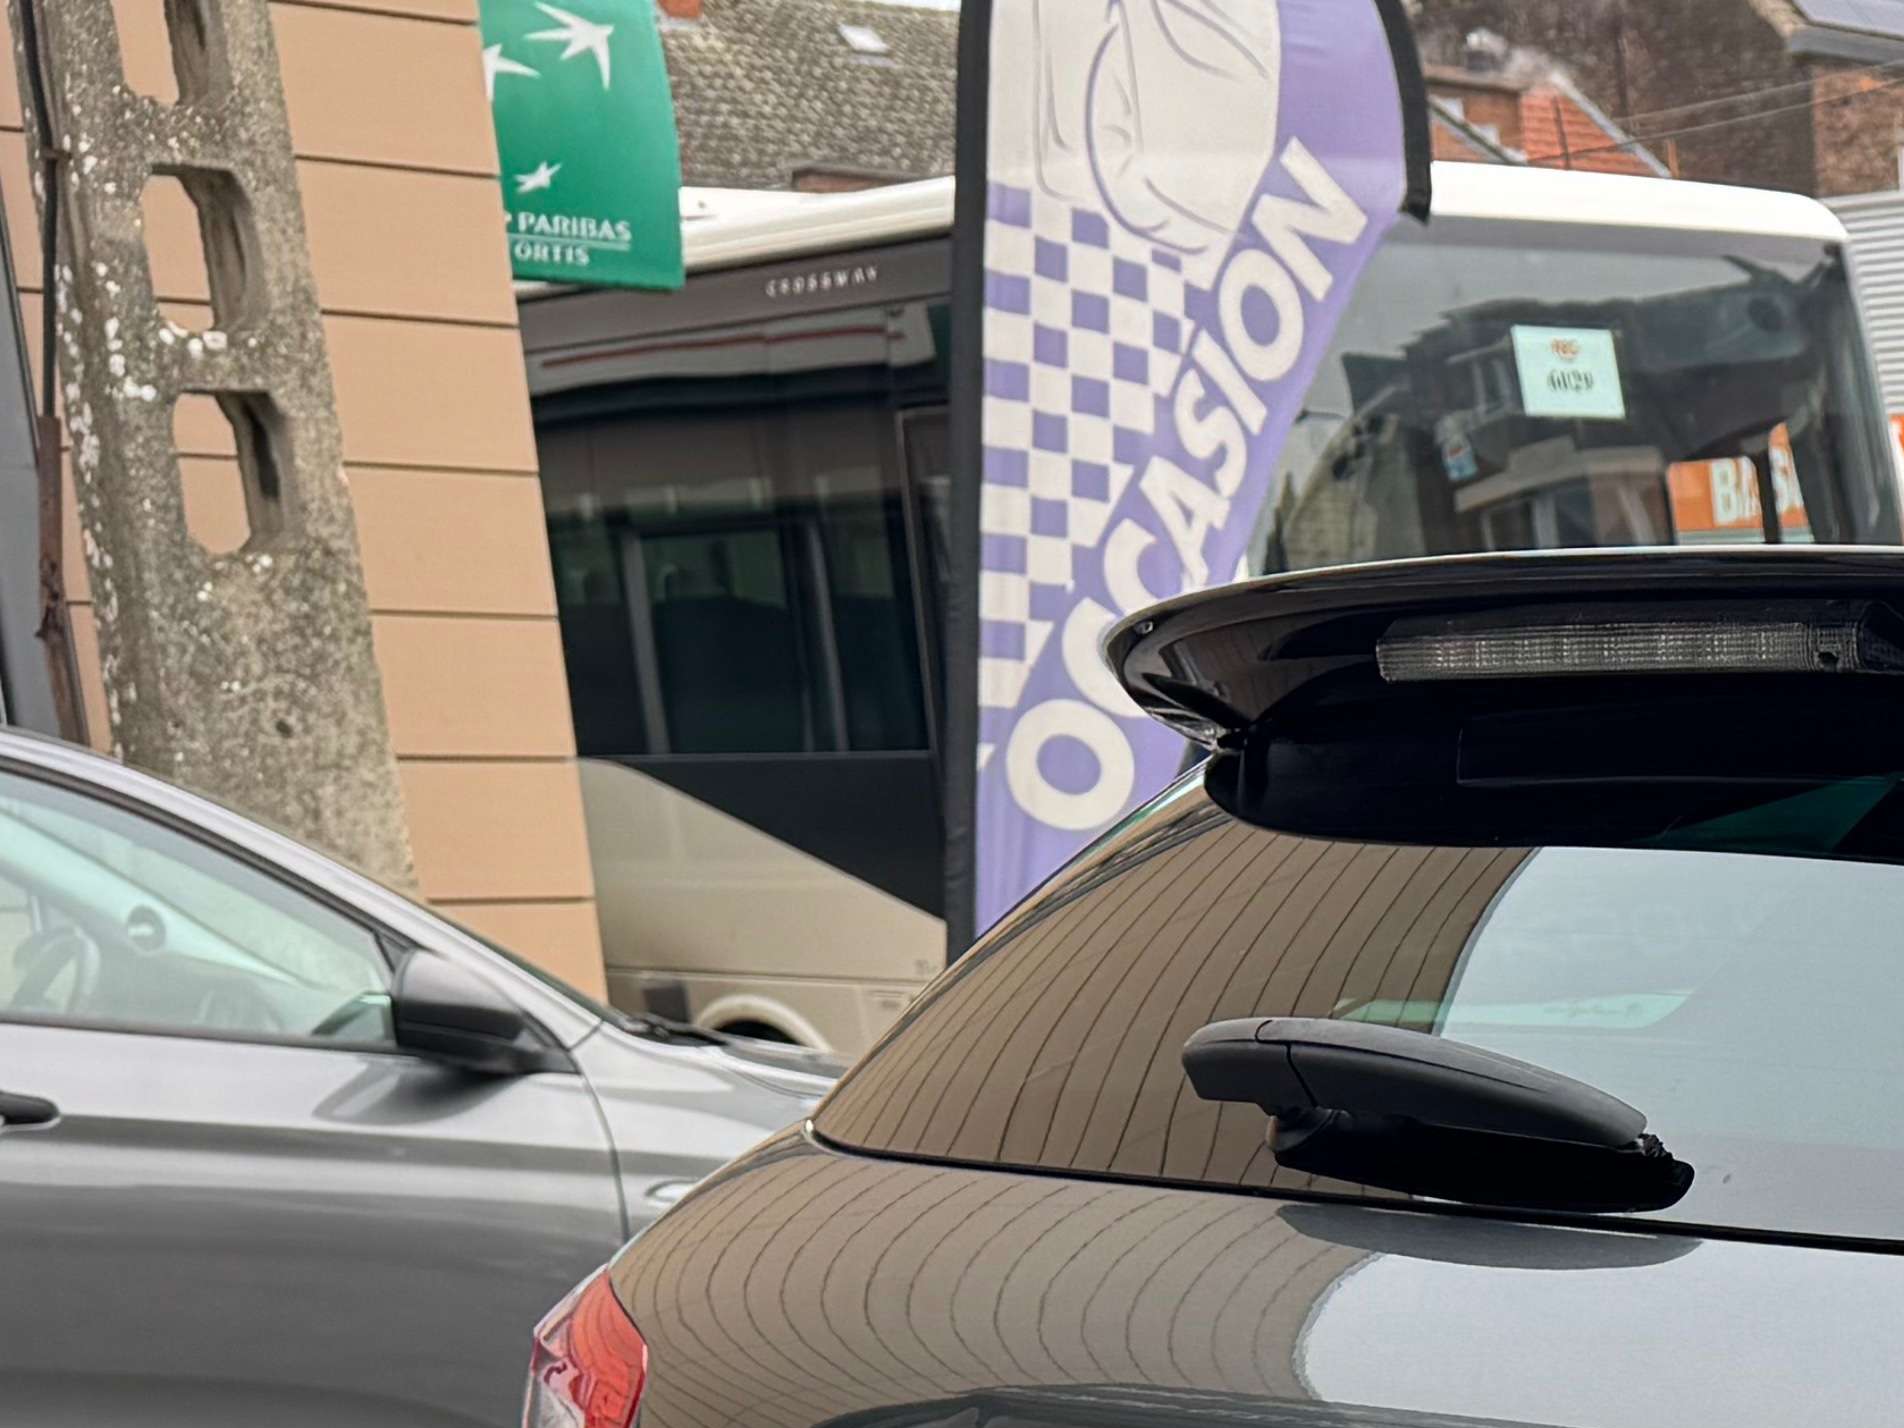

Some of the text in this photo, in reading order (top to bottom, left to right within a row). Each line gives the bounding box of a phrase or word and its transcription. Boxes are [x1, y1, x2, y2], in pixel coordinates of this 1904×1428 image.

[517, 211, 632, 242] PARIBAS
[514, 240, 590, 267] ORTIS
[1006, 137, 1368, 831] OCCASION
